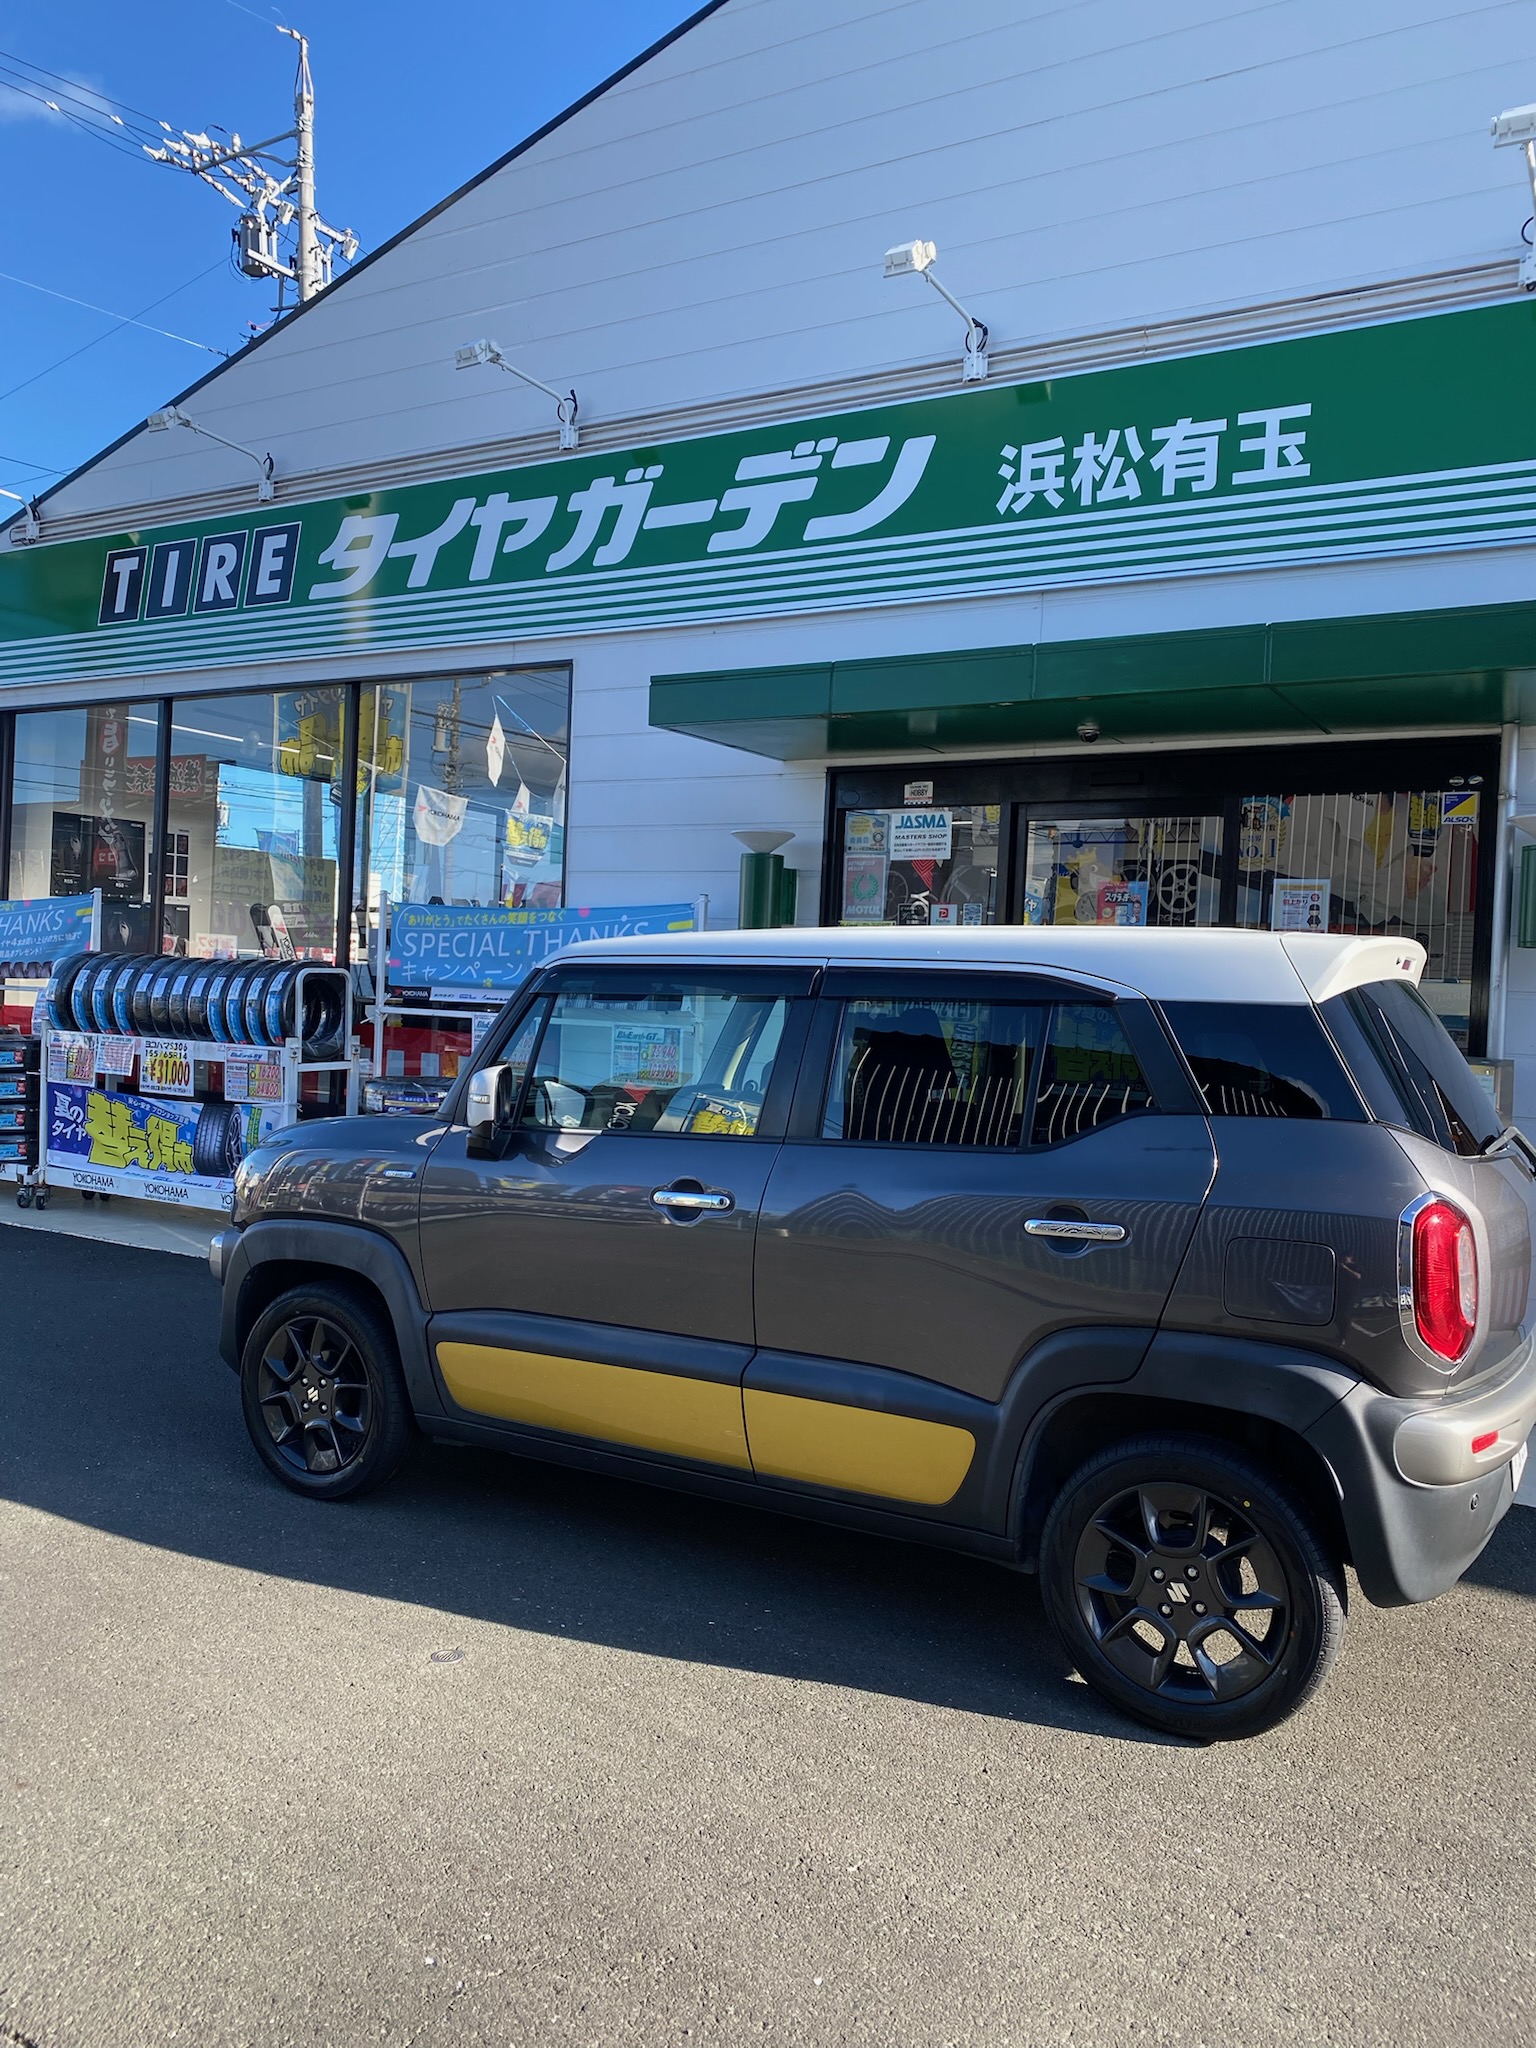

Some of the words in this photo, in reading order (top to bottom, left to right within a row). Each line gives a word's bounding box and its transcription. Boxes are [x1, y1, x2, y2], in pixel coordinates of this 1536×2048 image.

[112, 533, 289, 614] TIRE
[309, 435, 937, 600] タイヤガーデン
[995, 403, 1313, 515] 浜松有玉
[428, 810, 461, 822] YOKOHAMA
[895, 814, 947, 829] JASMA
[846, 905, 881, 915] MOTUL
[403, 930, 511, 958] SPECIAL
[54, 1090, 85, 1123] 夏の
[51, 1119, 87, 1141] タイヤ
[72, 1172, 115, 1188] YOKOHAMA
[144, 1183, 189, 1199] YOKOHAMA
